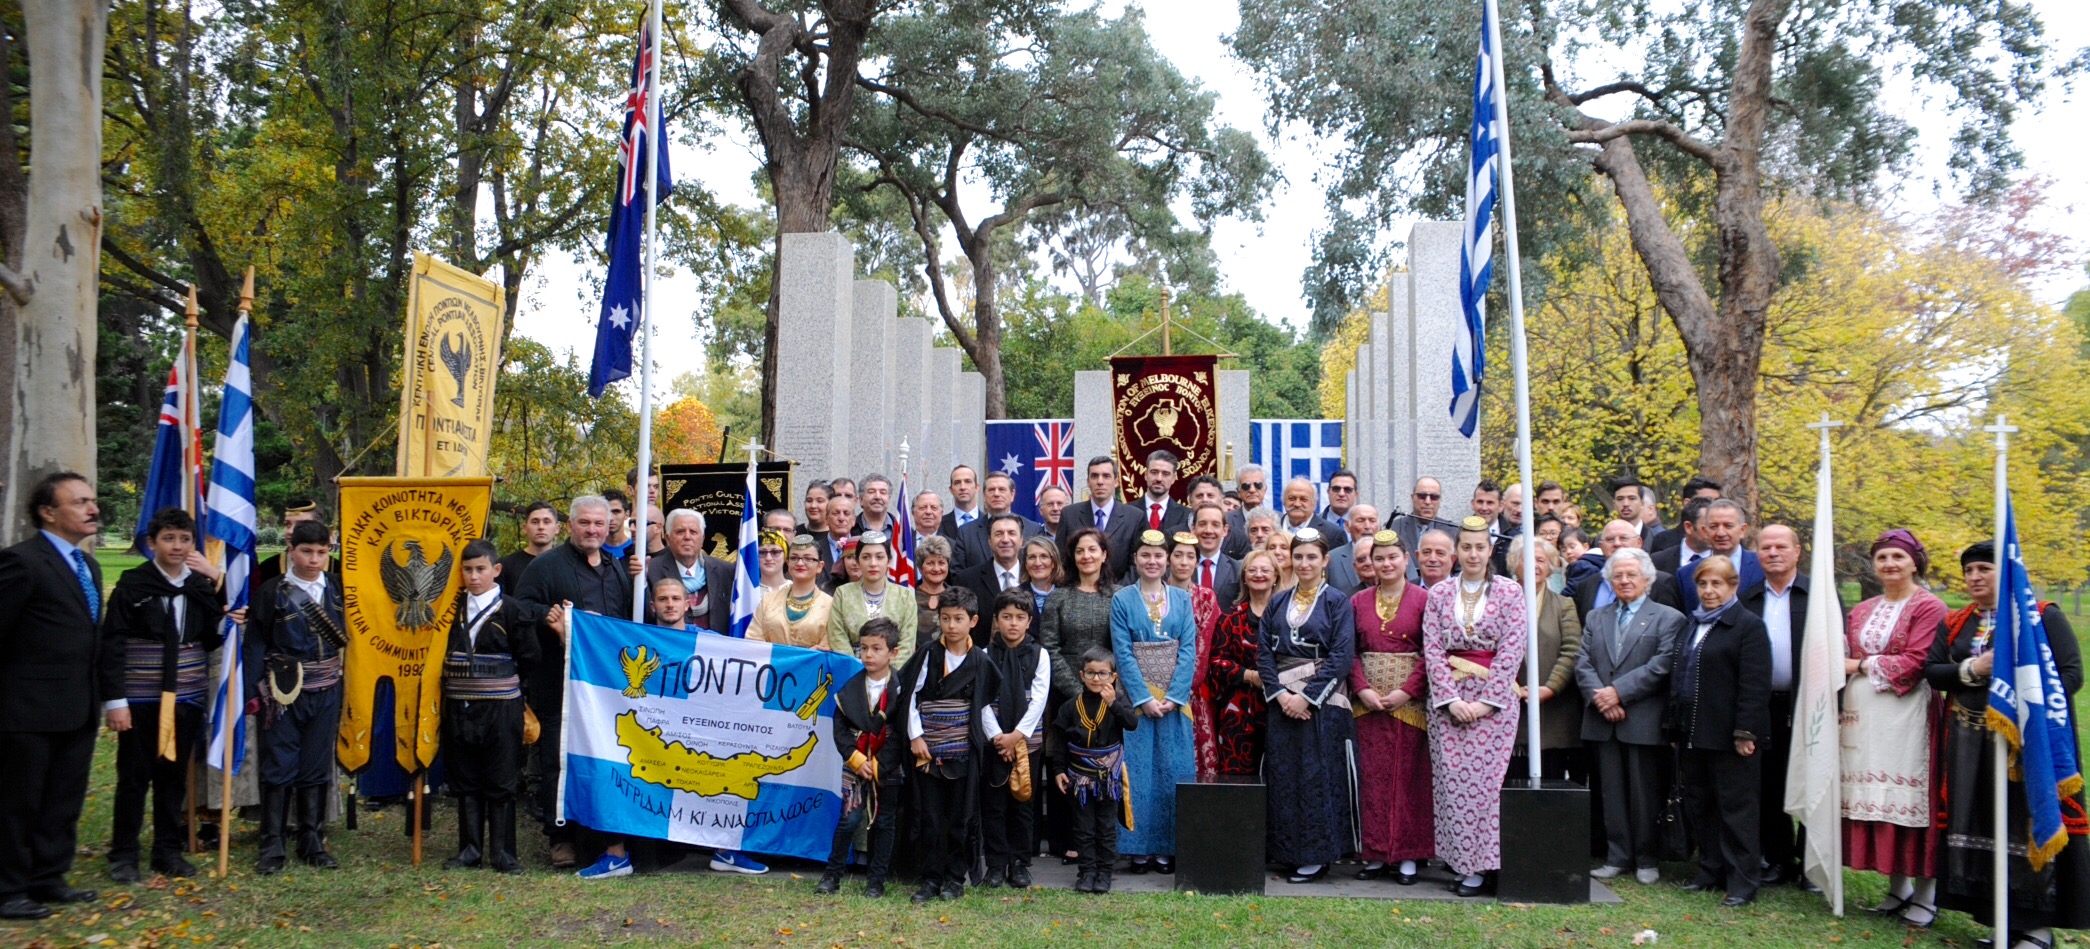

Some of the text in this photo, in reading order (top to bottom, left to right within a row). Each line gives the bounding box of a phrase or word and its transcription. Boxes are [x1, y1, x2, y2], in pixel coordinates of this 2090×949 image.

[1126, 383, 1139, 397] OF
[1139, 373, 1202, 397] MELBOURNE
[708, 508, 743, 517] VICTORI
[345, 489, 477, 572] ΠΟΝΤΙΑΚΗ ΚΟΙΝΟΤΗΤΑ ΜΕΛΒΟΥ
[367, 521, 389, 547] ΚΑΙ
[345, 586, 370, 635] PONTIAN
[682, 716, 774, 735] ΕΥΞΕΙΝΟΣ ΠΟΝΤΟΣ
